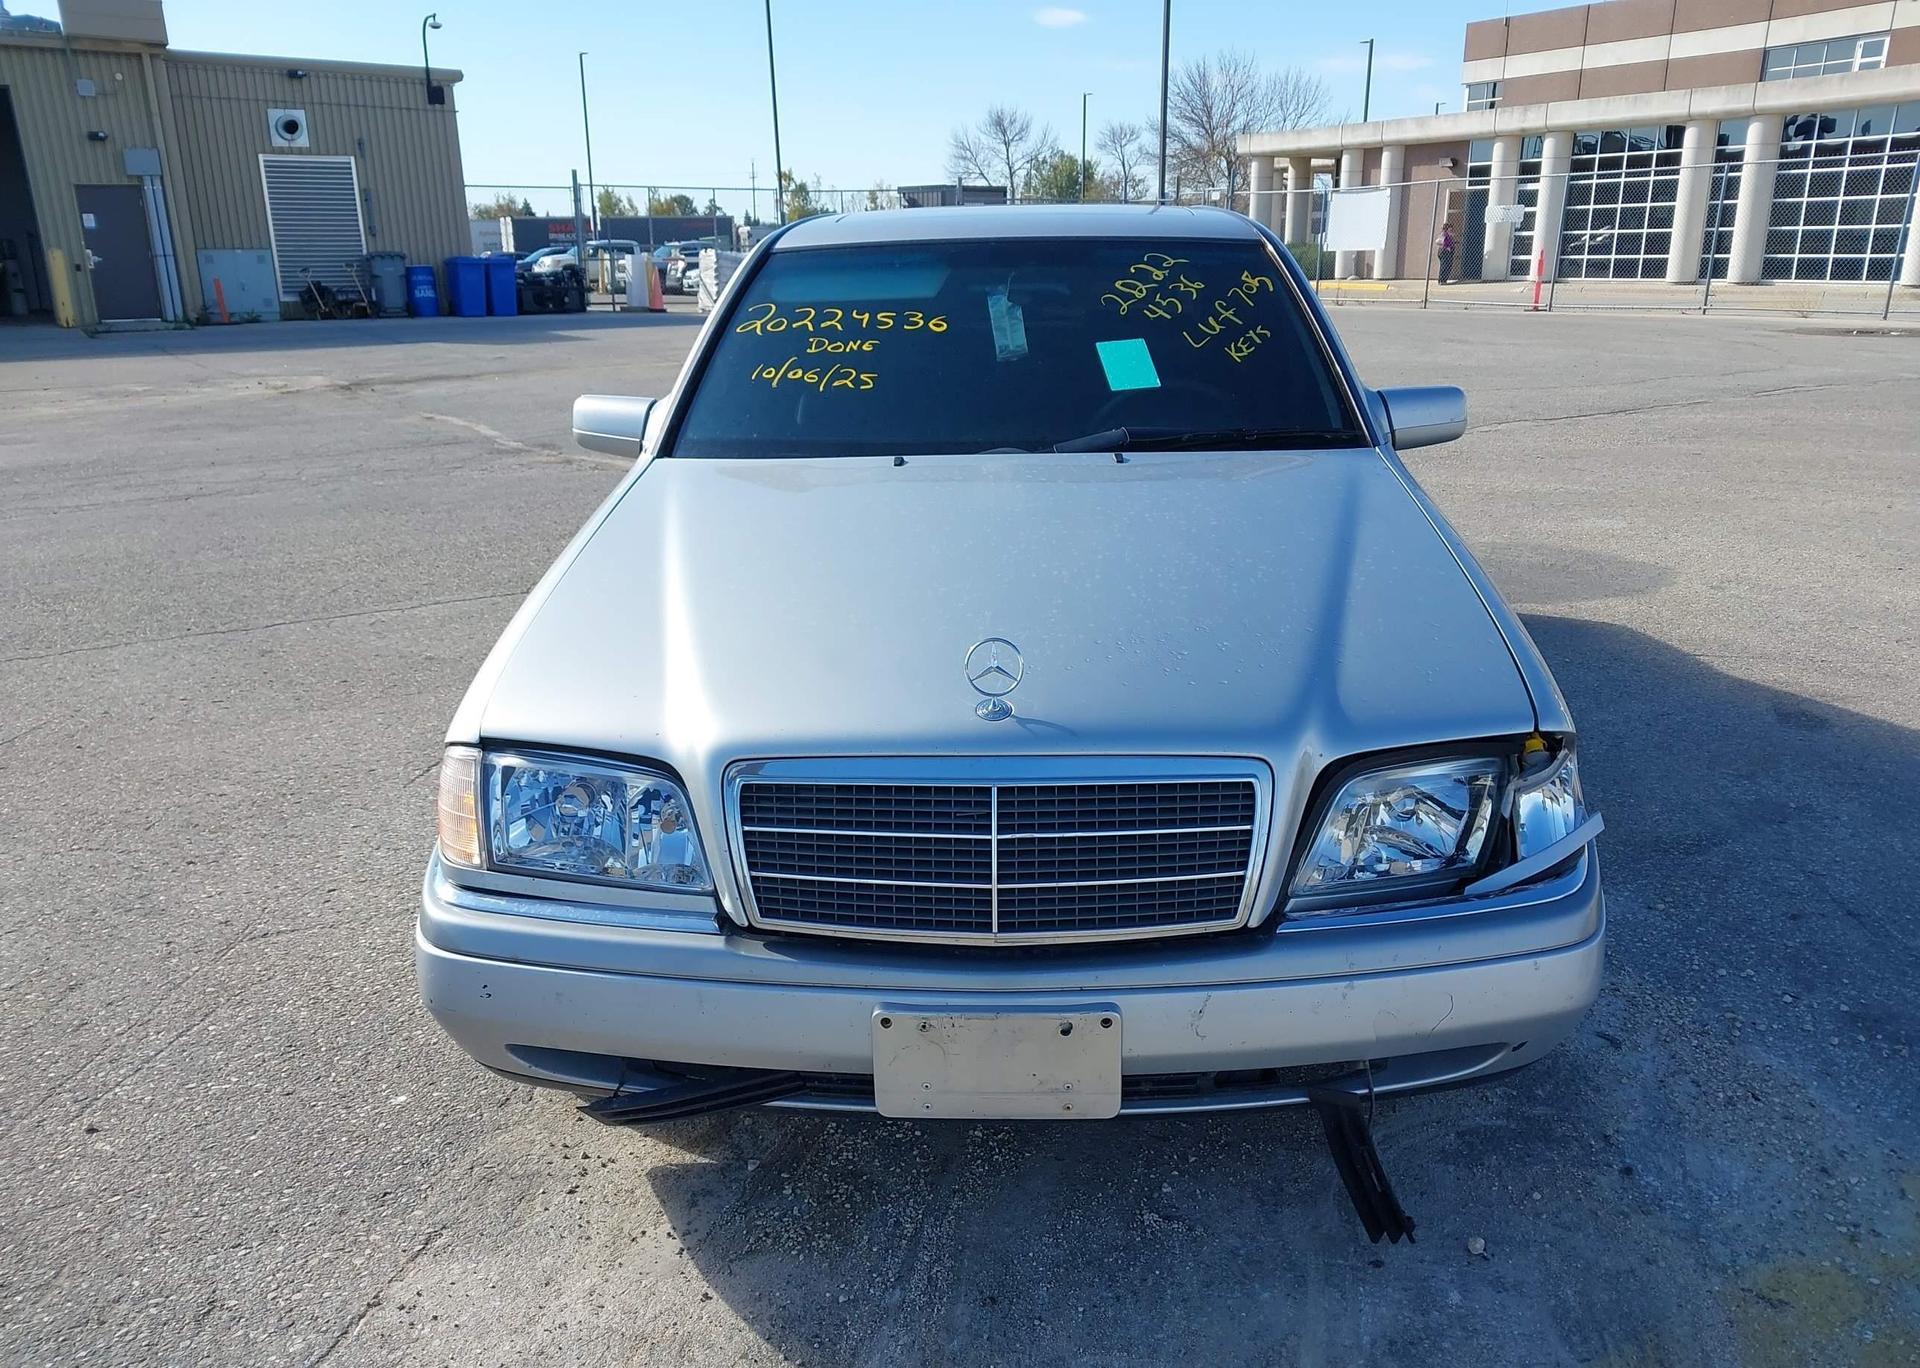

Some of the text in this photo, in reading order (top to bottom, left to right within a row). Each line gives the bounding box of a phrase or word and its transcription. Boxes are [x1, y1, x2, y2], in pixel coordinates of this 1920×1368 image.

[735, 302, 949, 336] 20224536
[806, 336, 881, 353] DONE
[1223, 324, 1272, 363] KEYS
[751, 356, 879, 392] 10/06/25
